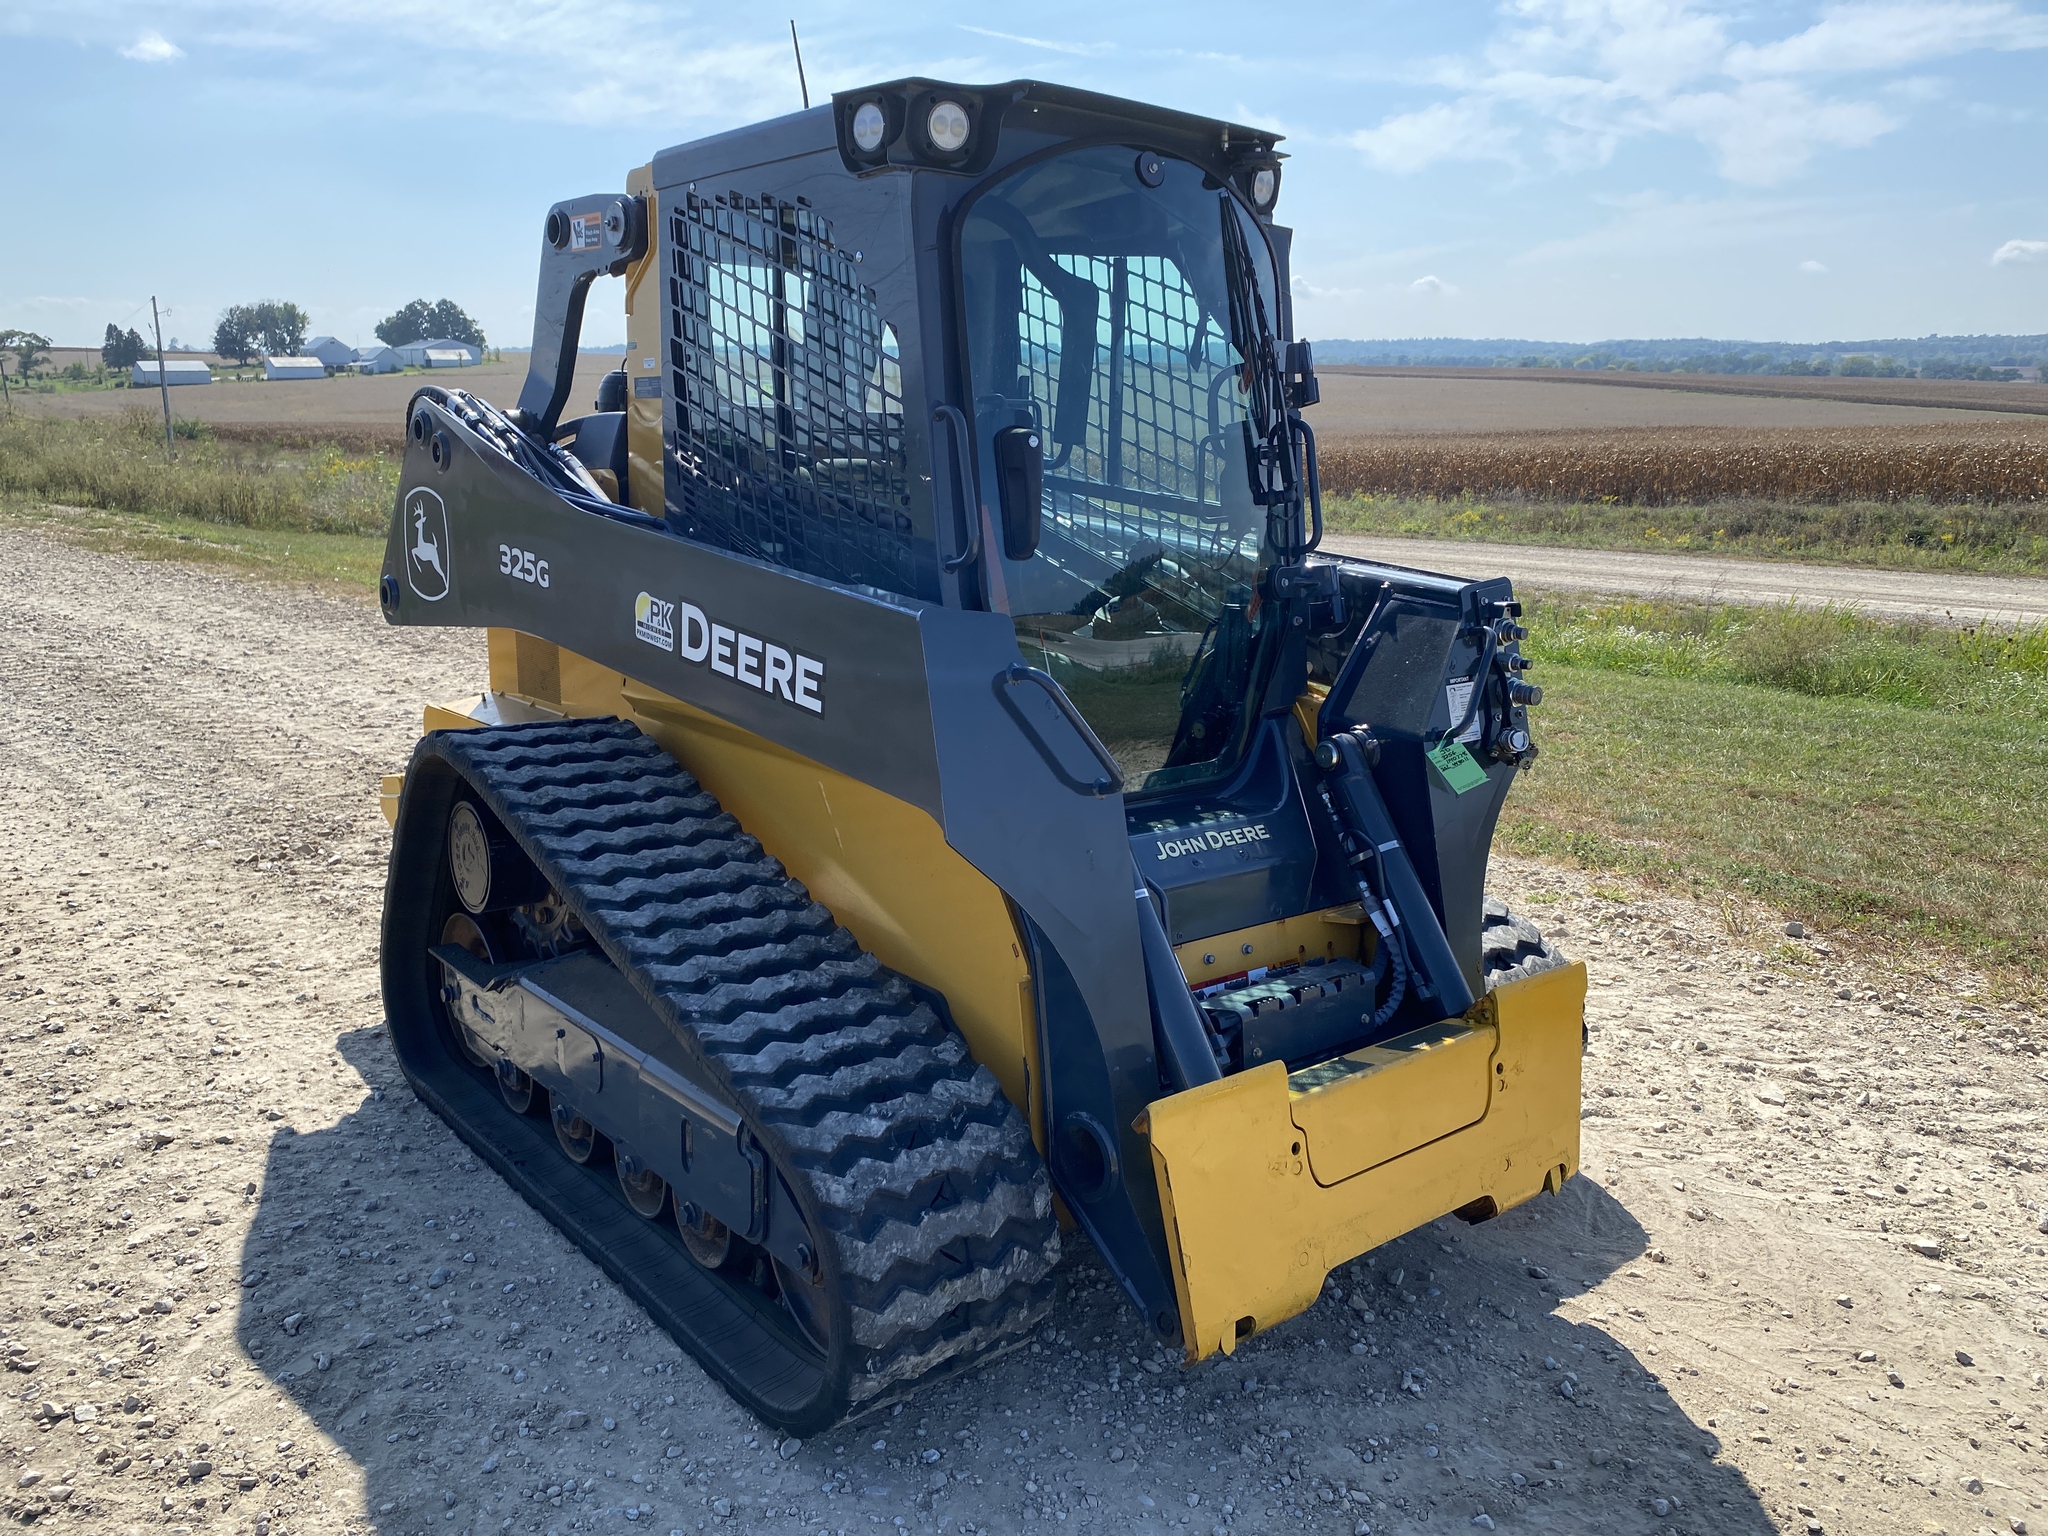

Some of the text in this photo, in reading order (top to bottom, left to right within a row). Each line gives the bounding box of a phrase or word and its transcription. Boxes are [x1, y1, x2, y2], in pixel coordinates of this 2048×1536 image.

[500, 543, 549, 588] 325G
[636, 628, 673, 649] PKMIDWEST.COM
[681, 602, 823, 714] DEERE
[1156, 824, 1270, 861] JOHN DEERE
